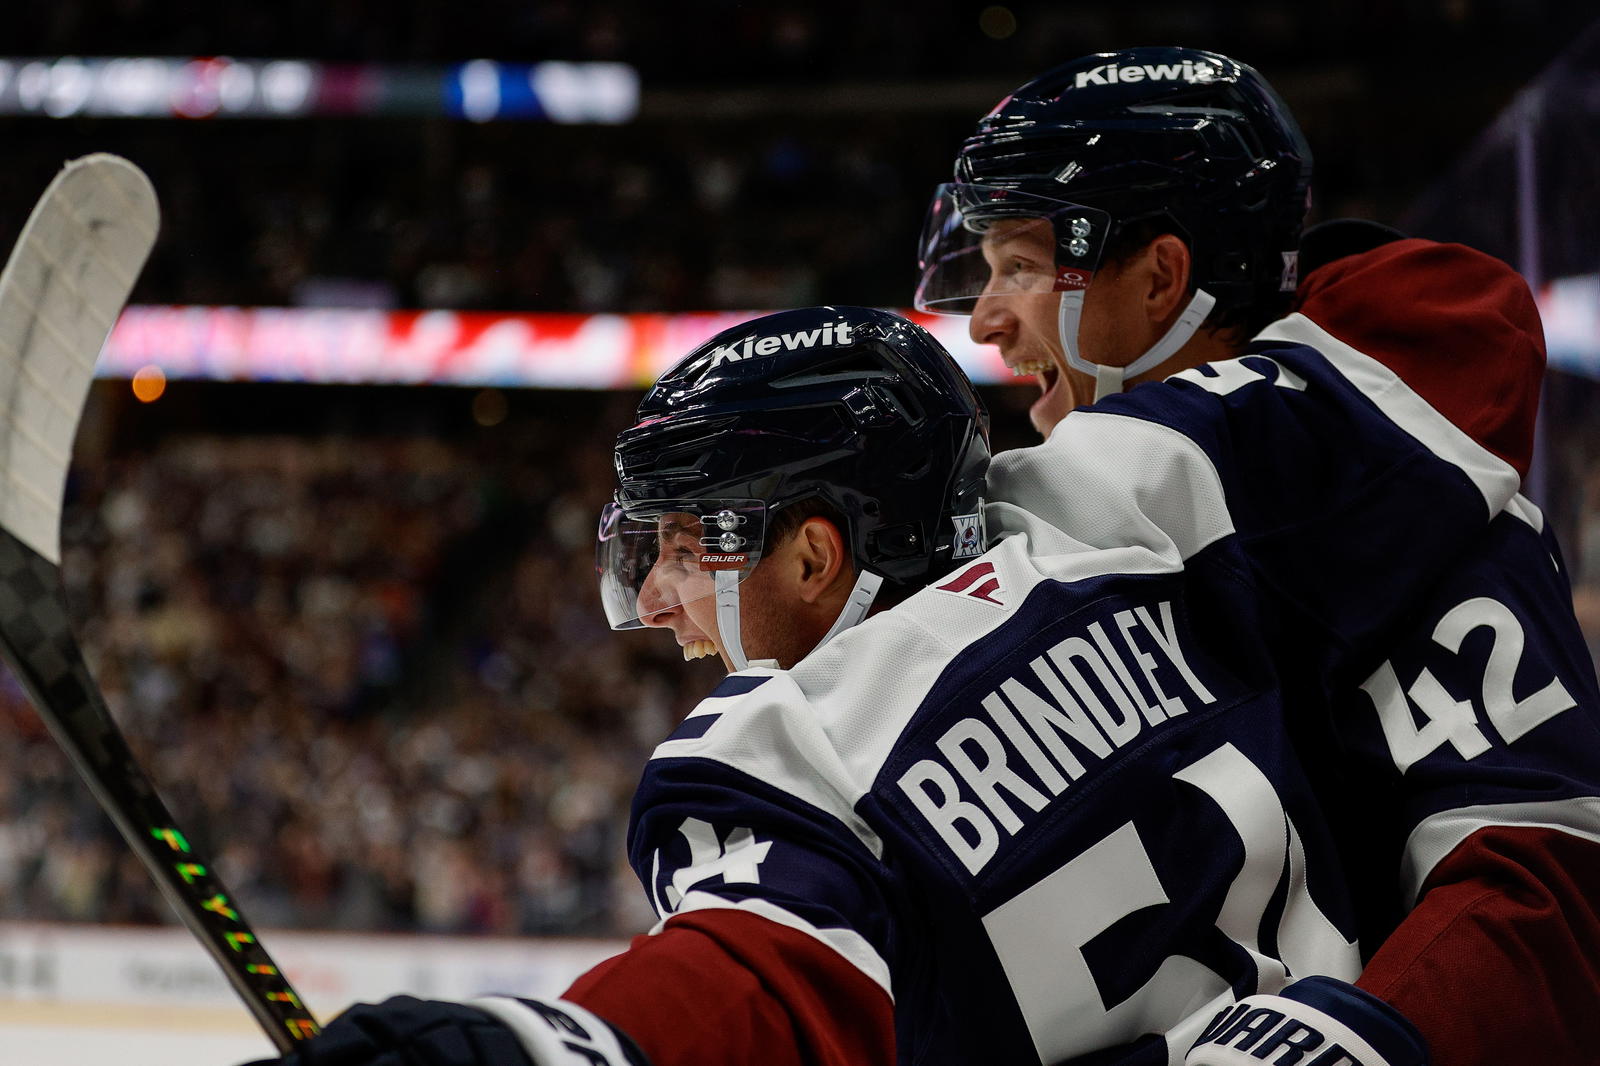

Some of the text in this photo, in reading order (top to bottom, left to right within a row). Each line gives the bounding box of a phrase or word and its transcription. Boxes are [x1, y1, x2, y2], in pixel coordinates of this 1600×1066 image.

[1076, 60, 1214, 88] Kiewit
[712, 321, 853, 368] Kiewit
[897, 601, 1217, 876] BRINDLEY
[1360, 597, 1578, 775] 42
[151, 826, 321, 1040] FLYLITE
